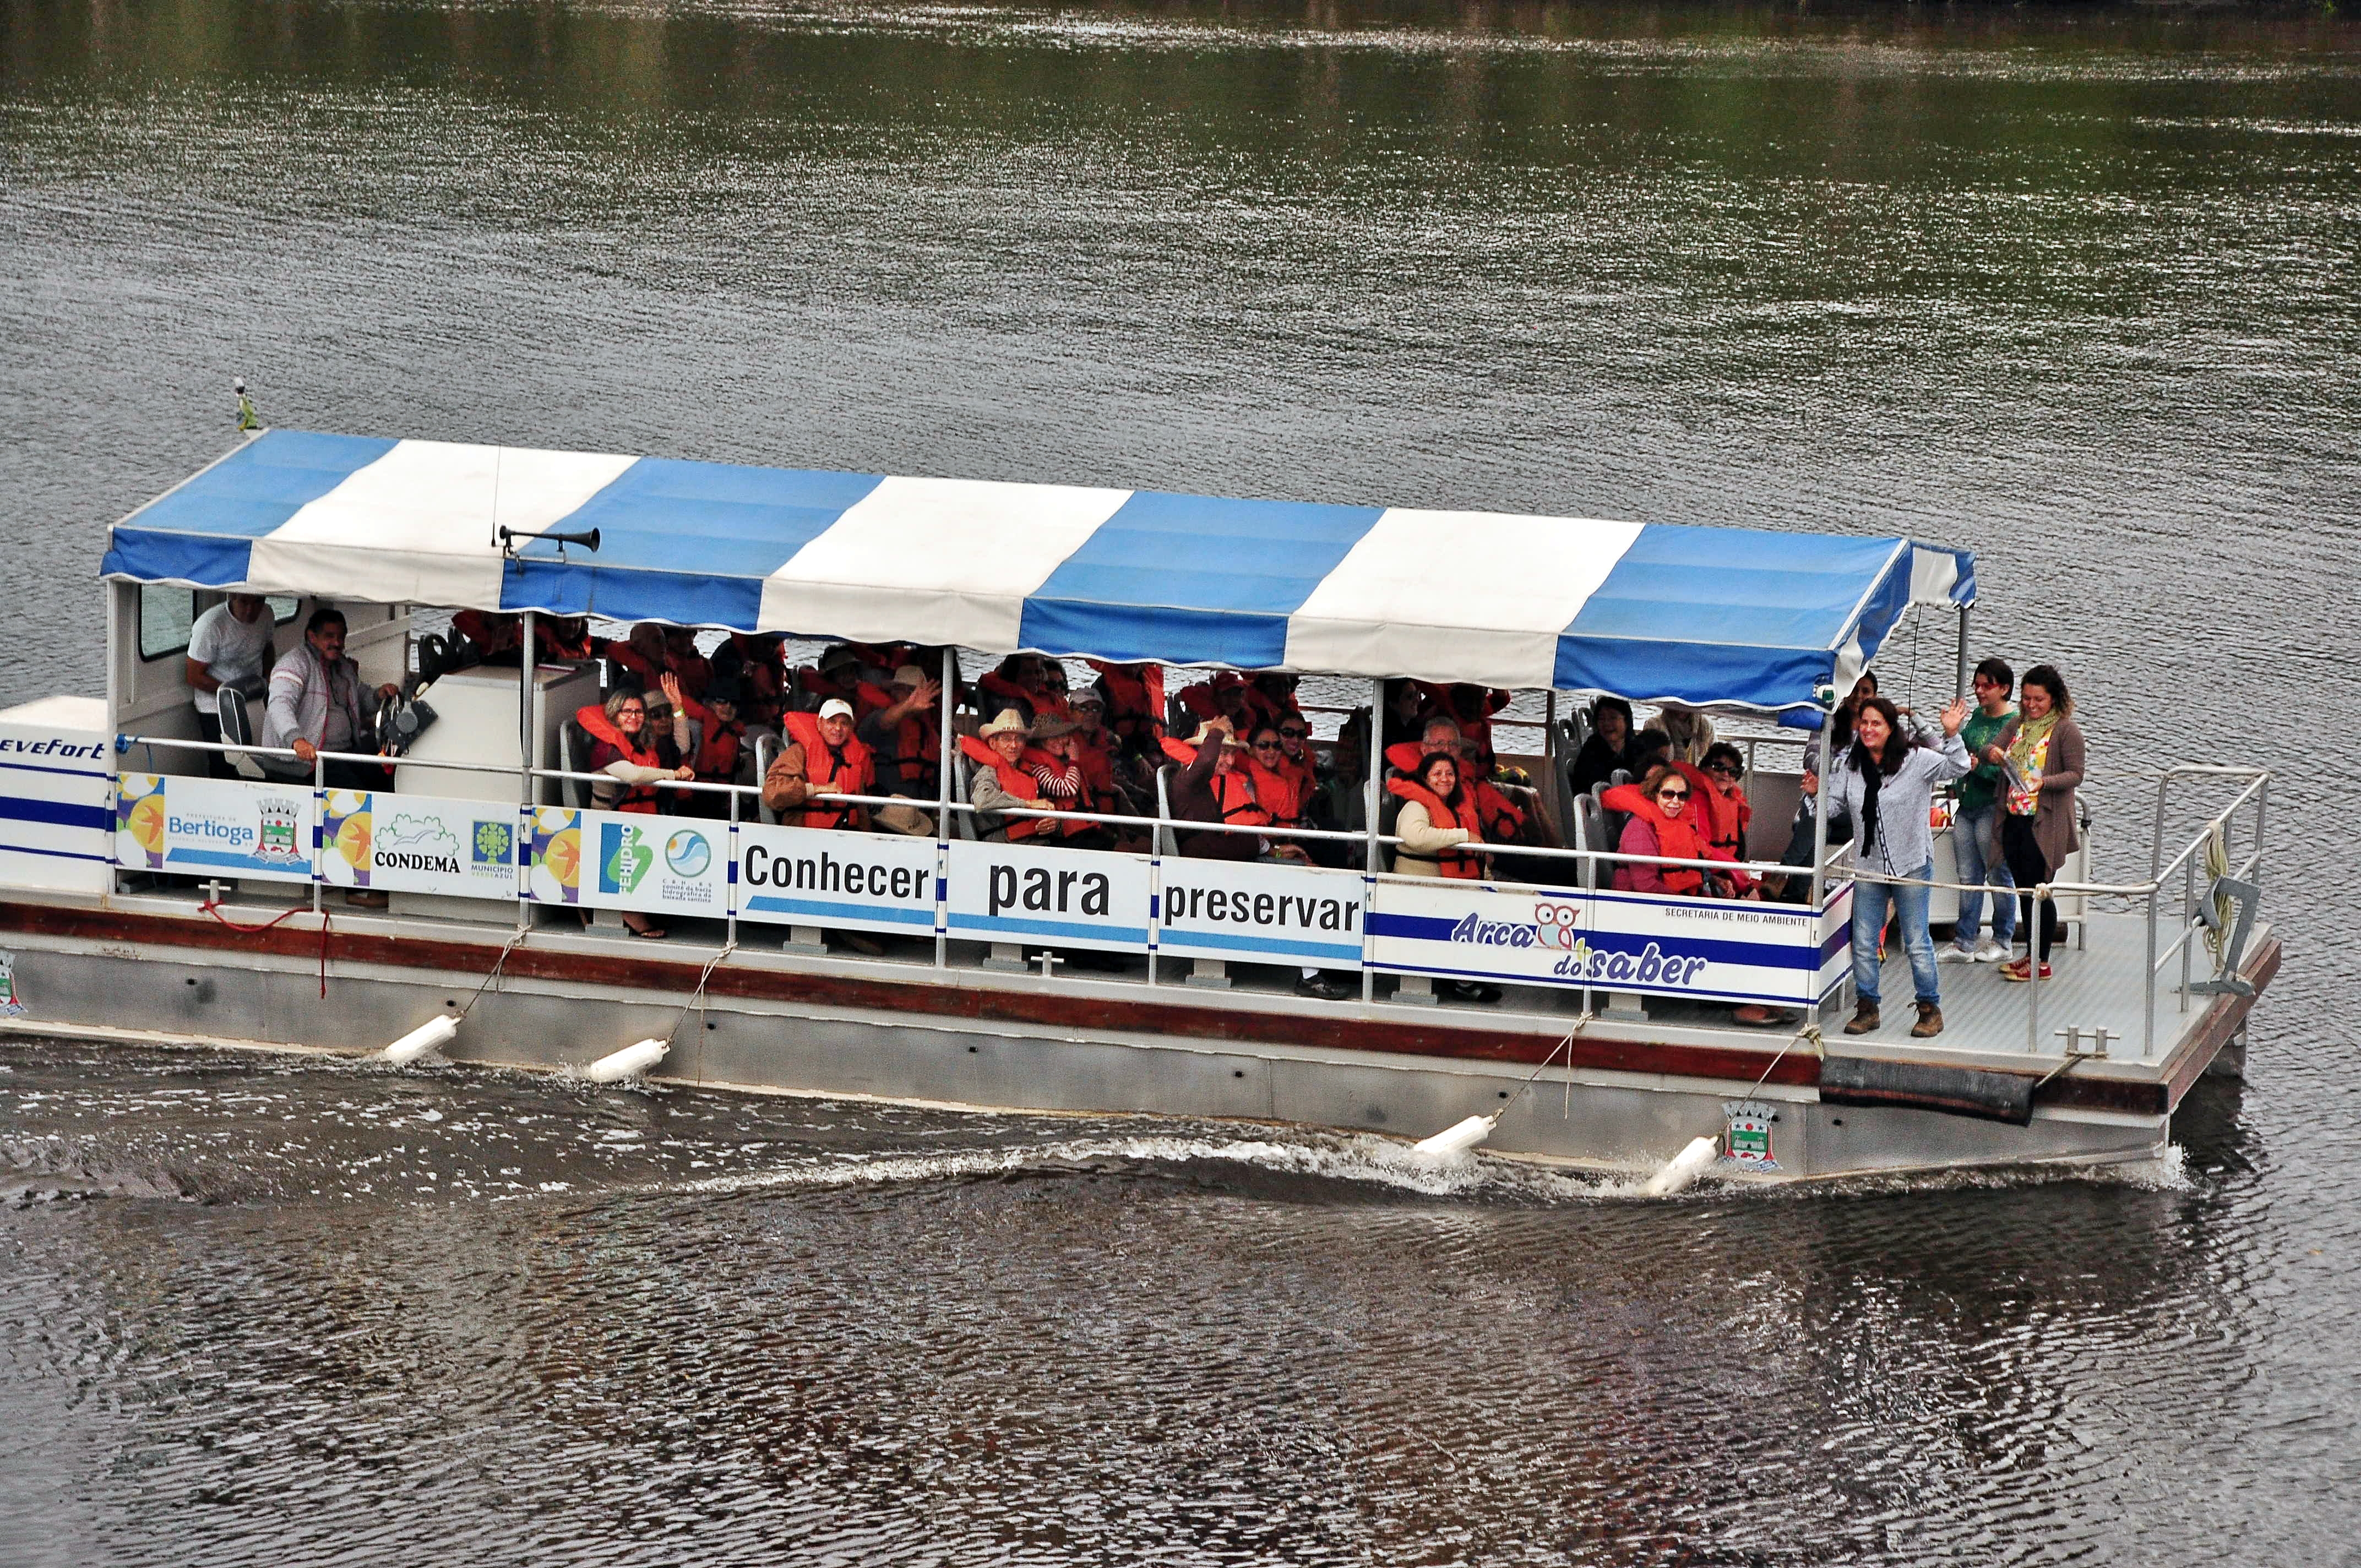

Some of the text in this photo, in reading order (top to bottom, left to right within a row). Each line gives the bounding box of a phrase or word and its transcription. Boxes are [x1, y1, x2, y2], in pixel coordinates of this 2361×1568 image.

[169, 816, 253, 846] Bertioga
[374, 851, 460, 873] CONDEMA
[746, 845, 929, 899] Conhecer
[989, 865, 1109, 917] para
[1165, 886, 1359, 931] preservar
[1452, 912, 1535, 949] Arca
[1665, 908, 1808, 927] SECRETARIA DE MEIO AMBIENTE
[1553, 942, 1706, 986] do saber
